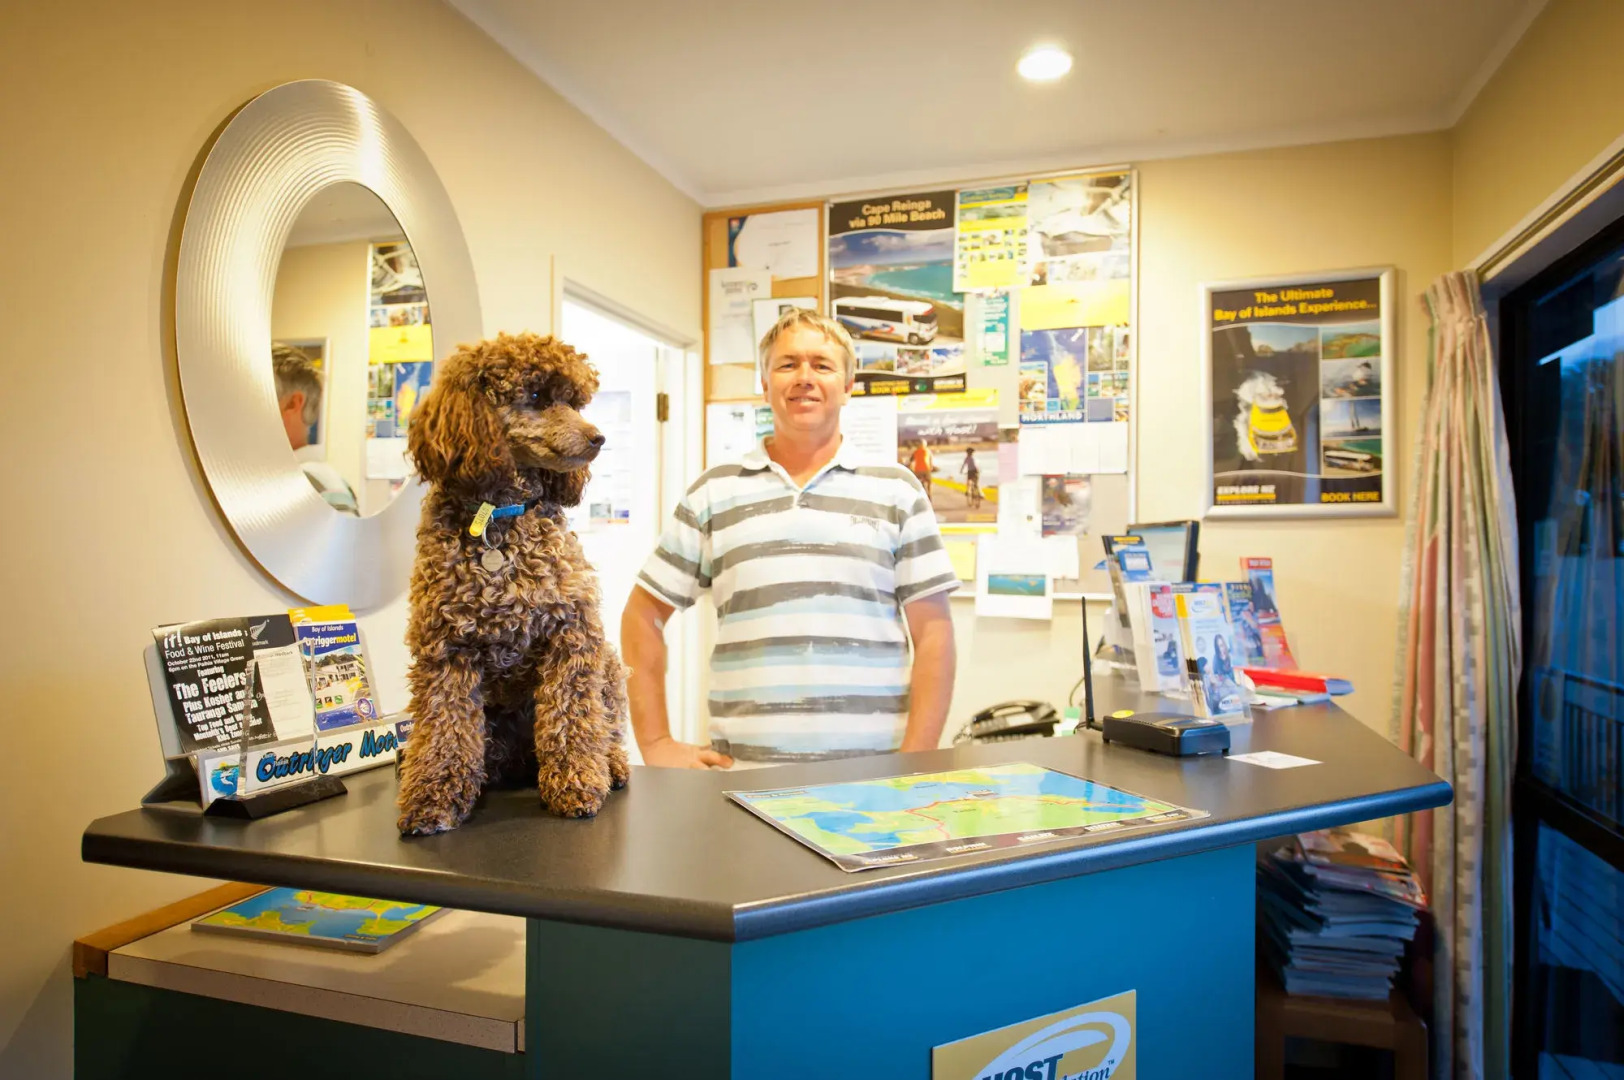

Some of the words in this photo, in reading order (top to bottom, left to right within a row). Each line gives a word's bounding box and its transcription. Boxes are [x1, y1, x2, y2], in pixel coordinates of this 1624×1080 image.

[862, 204, 891, 215] Cape
[892, 200, 932, 212] Reinga
[849, 217, 866, 228] via
[867, 215, 881, 226] 90
[883, 212, 908, 224] Mile
[910, 209, 946, 221] Beach
[1254, 292, 1278, 304] The
[1280, 288, 1334, 302] Ultimate
[1213, 309, 1237, 322] Bay
[1239, 307, 1253, 318] of
[1254, 304, 1297, 317] Islands
[1299, 299, 1377, 314] Experience...
[1321, 492, 1351, 502] BOOK
[1352, 491, 1379, 502] HERE
[183, 635, 200, 645] Bay
[202, 633, 212, 642] of
[212, 629, 243, 641] Islands
[165, 649, 186, 660] Food
[187, 647, 194, 656] &
[194, 645, 215, 655] Wine
[216, 639, 245, 651] Festival
[167, 659, 189, 667] October
[197, 665, 225, 677] Featuring
[173, 682, 200, 700] The
[201, 672, 247, 694] Feelers
[183, 700, 203, 713] Plus
[203, 692, 233, 708] Kosher
[185, 706, 227, 725] Tauranga
[227, 699, 258, 713] Sama
